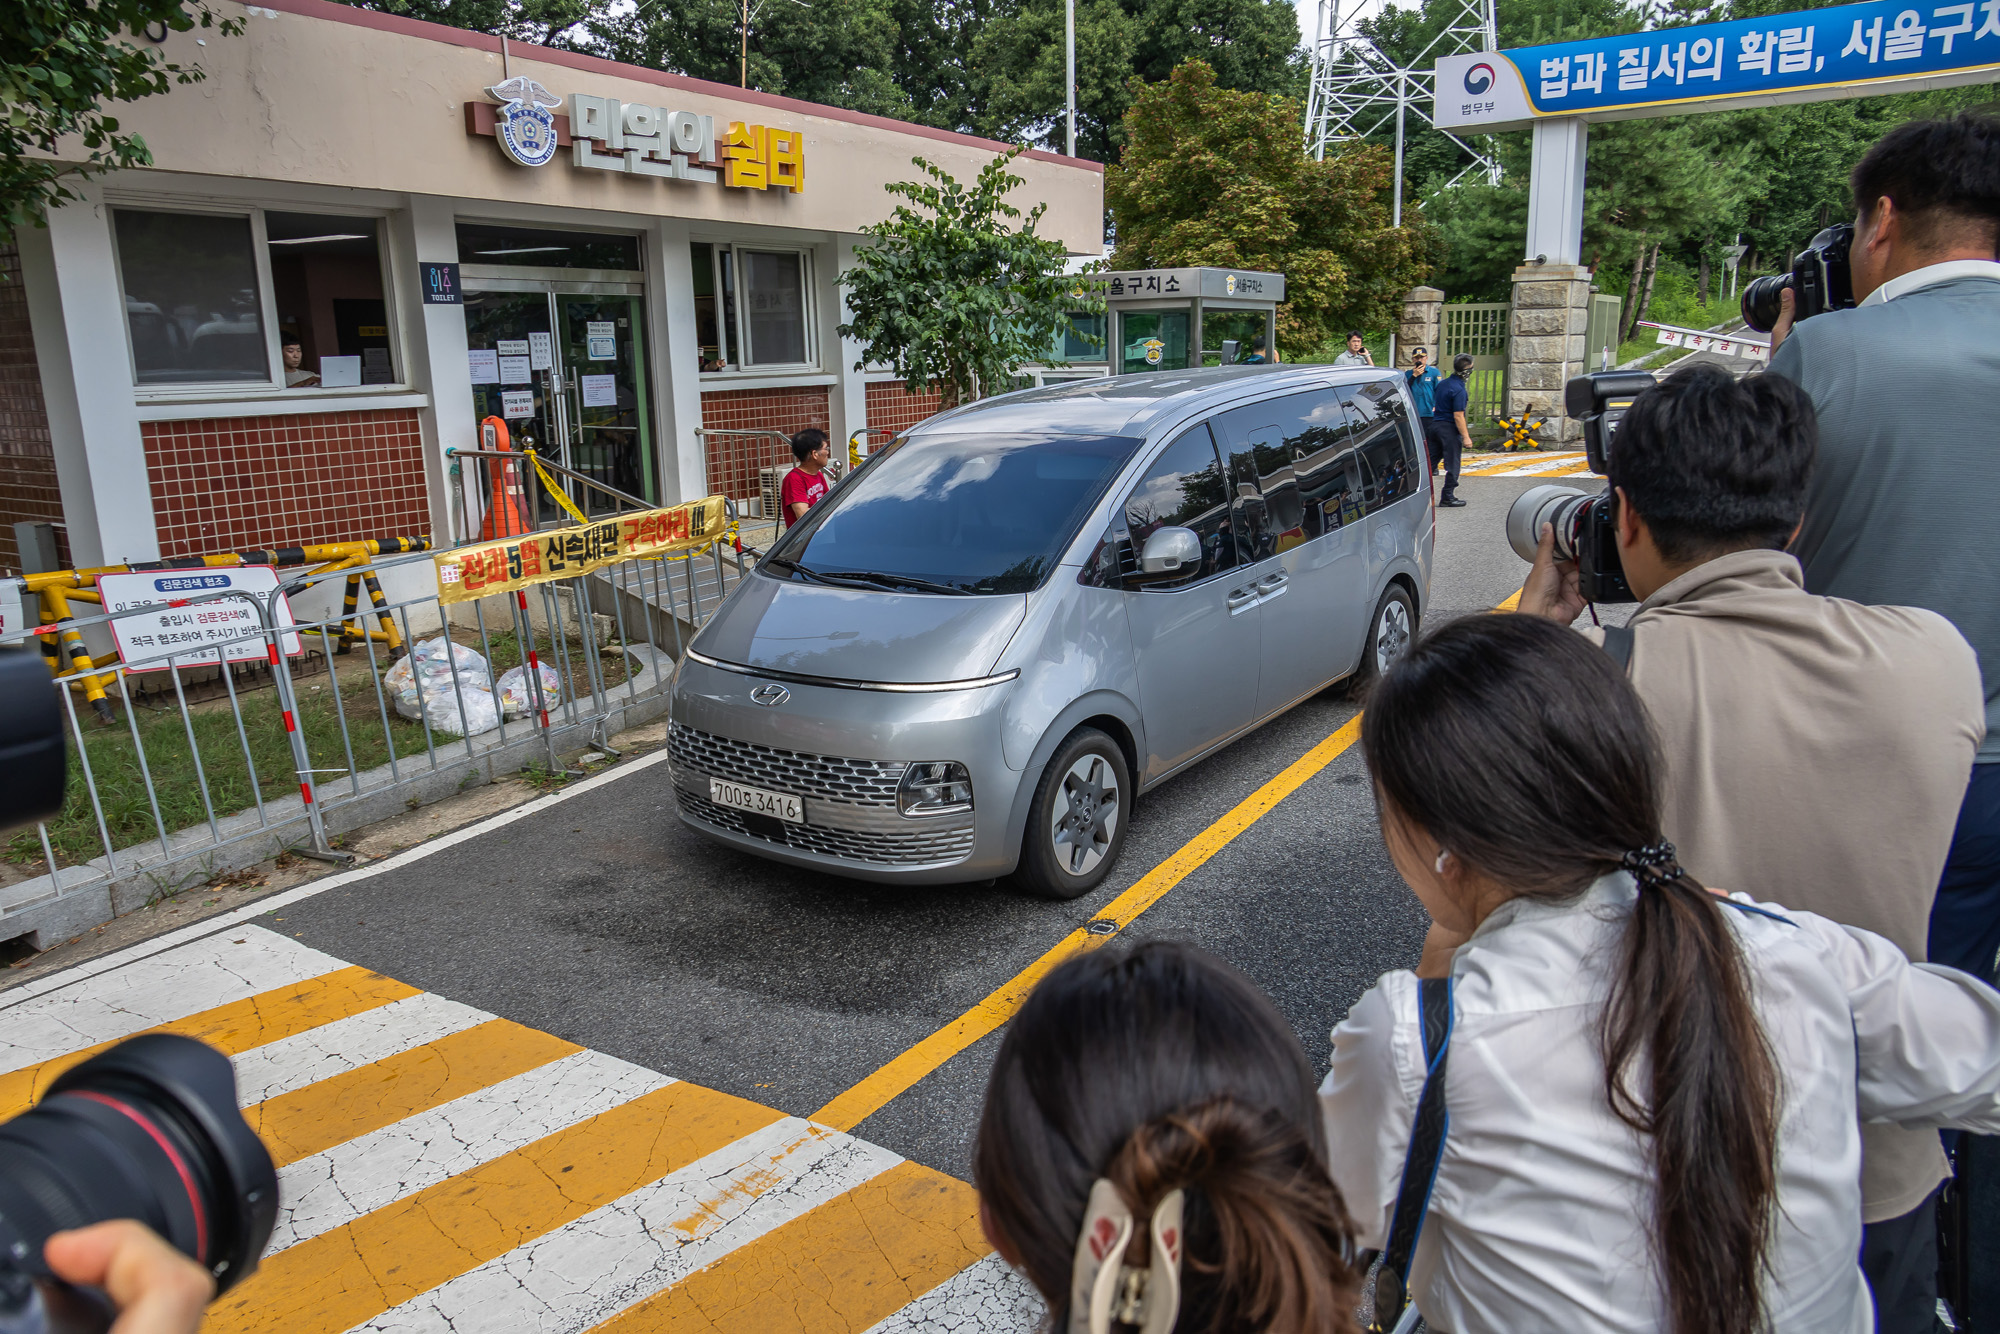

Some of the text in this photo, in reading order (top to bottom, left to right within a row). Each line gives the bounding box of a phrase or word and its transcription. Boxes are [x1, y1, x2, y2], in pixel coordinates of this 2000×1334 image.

[1540, 51, 1608, 100] 법과
[1617, 36, 1725, 92] 질서의
[1737, 25, 1825, 76] 확립,
[1461, 101, 1495, 116] 법무부
[568, 93, 804, 194] 민원인 쉼터
[1235, 277, 1263, 294] 서울구치소
[431, 294, 455, 302] TOILET
[460, 540, 541, 591] 전과5범
[545, 522, 619, 572] 신속재판
[161, 576, 226, 590] 검문검색 협조
[159, 608, 251, 627] 출입시 검문검색에
[130, 635, 154, 648] 적극
[157, 630, 204, 646] 협조하여
[206, 626, 239, 640] 주시기
[715, 782, 796, 818] 700호 3416
